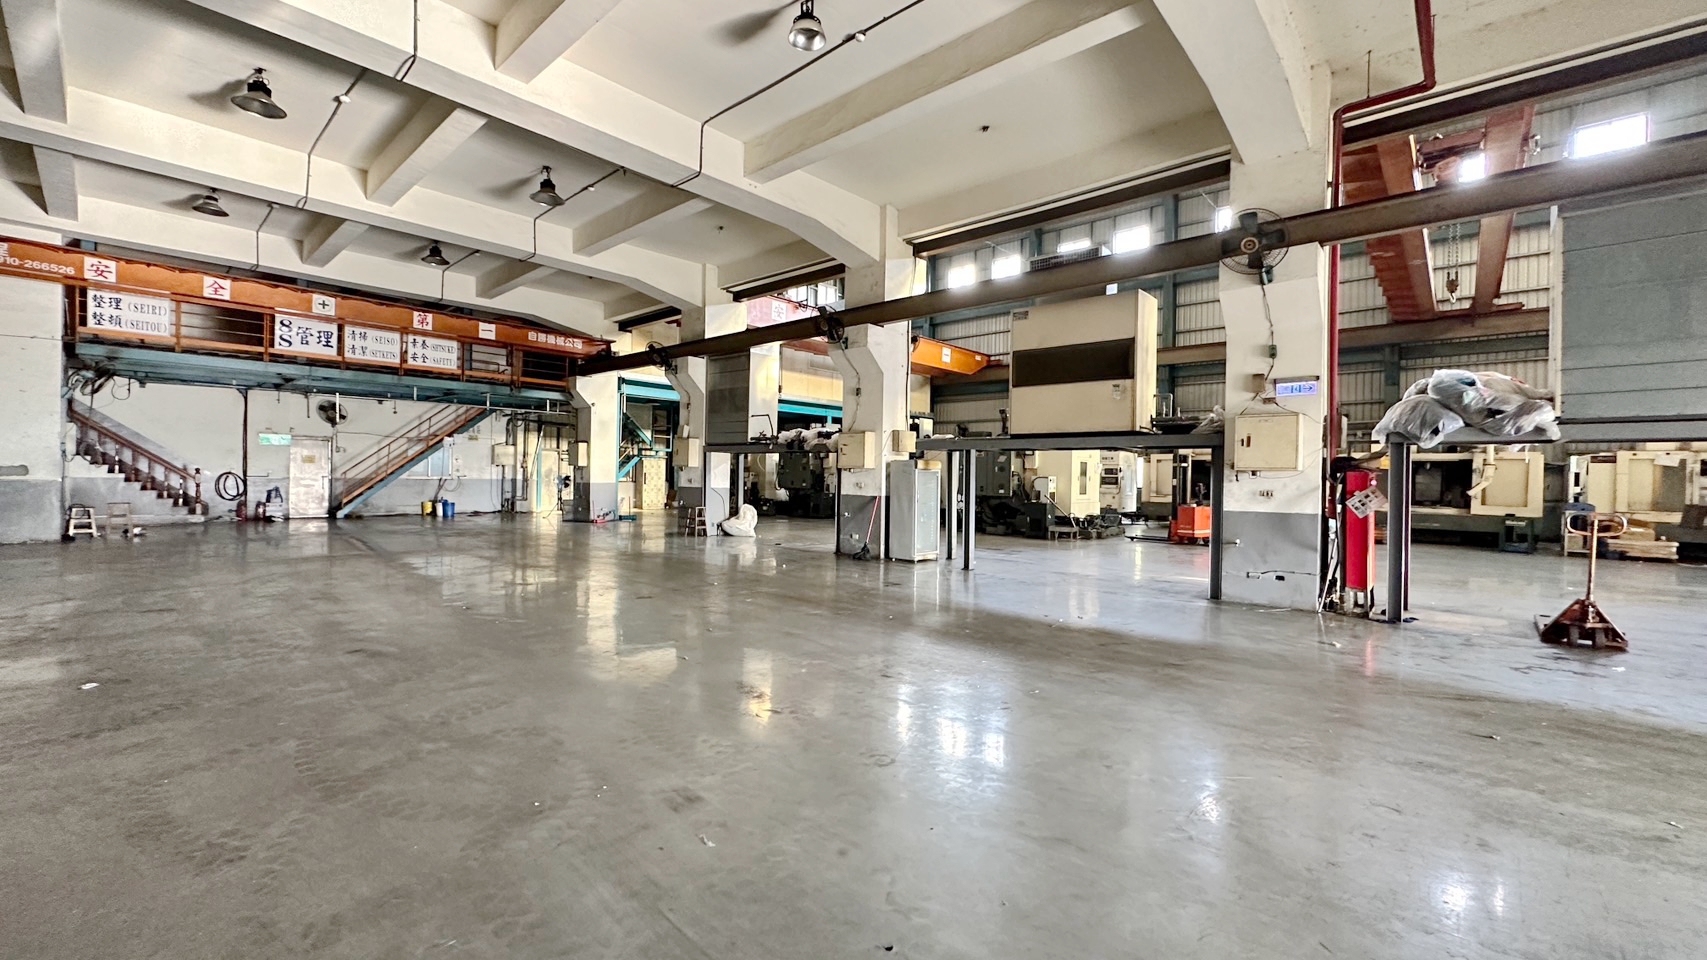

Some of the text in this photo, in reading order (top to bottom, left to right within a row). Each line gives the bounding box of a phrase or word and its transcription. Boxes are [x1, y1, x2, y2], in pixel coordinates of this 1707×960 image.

[86, 260, 113, 280] 安
[206, 280, 229, 297] 全
[416, 313, 430, 328] 第
[91, 293, 168, 316] 整理 (SEIRI)
[91, 311, 168, 333] 整頓 (SEITOU)
[347, 329, 369, 343] 清掃
[347, 344, 369, 357] 清潔
[409, 351, 430, 364] 安全
